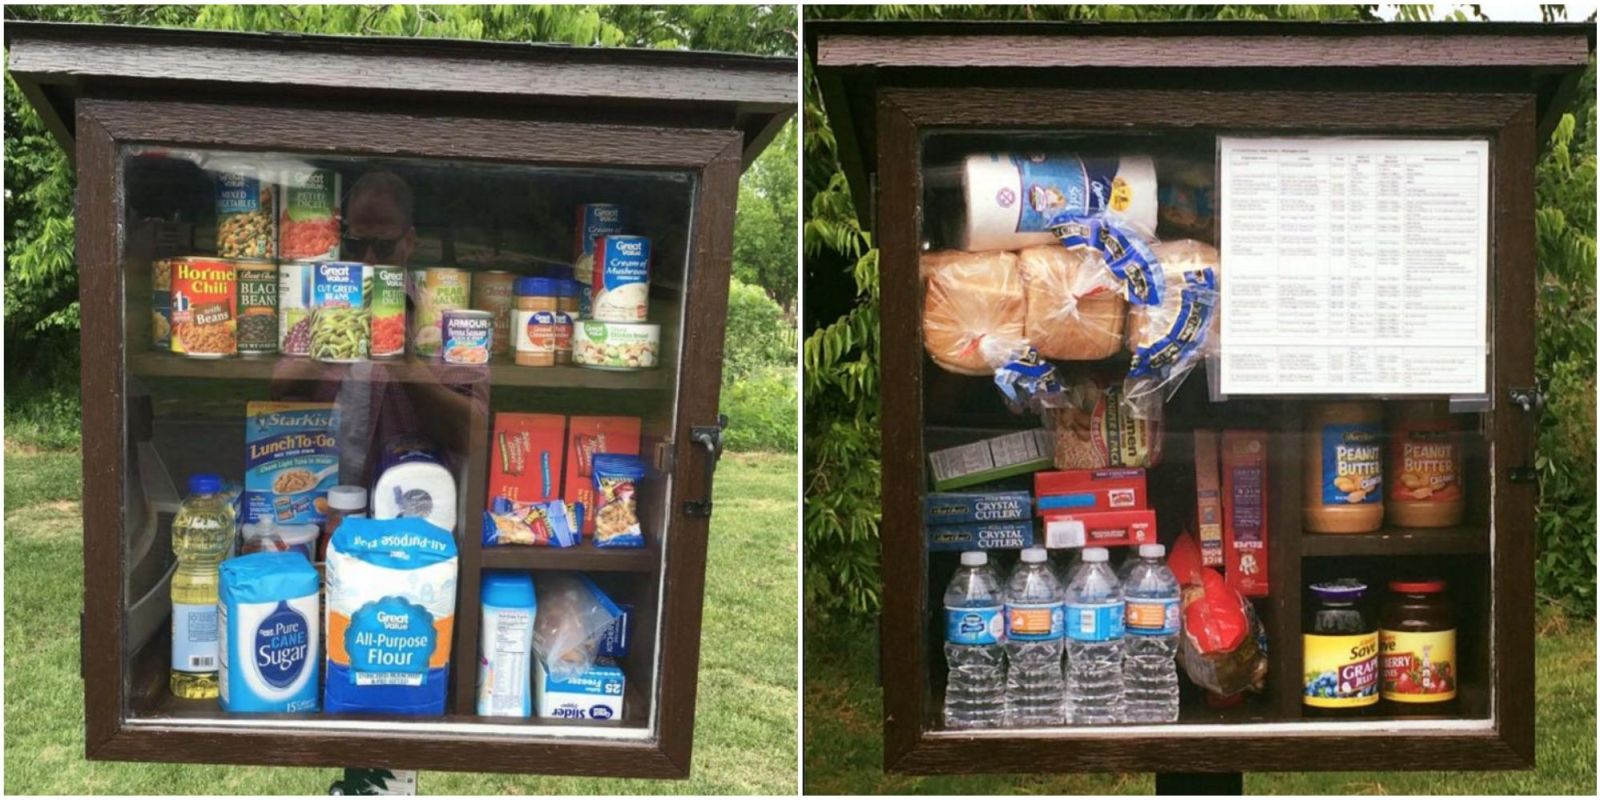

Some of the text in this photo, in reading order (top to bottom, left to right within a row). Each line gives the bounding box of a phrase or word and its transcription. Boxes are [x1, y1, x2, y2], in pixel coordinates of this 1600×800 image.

[222, 190, 247, 199] MIXED
[616, 241, 642, 250] Great
[610, 258, 648, 269] Cream of
[320, 264, 350, 276] Great
[607, 267, 648, 275] Mushroom
[326, 275, 350, 283] Value
[191, 280, 228, 294] Chili
[317, 284, 358, 293] CUT GREEN
[196, 312, 229, 325] Beans
[448, 319, 488, 328] ARMOUR
[269, 413, 334, 427] StarKist
[1126, 415, 1137, 457] men
[250, 435, 295, 460] Lunch
[1336, 445, 1379, 461] PEANUT
[1404, 444, 1452, 459] PEANUT
[1404, 458, 1453, 472] BUTTER
[975, 500, 1019, 511] CRYSTAL
[975, 509, 1022, 520] CUTLERY
[978, 530, 1022, 538] CRYSTAL
[381, 534, 447, 551] All-Purpose
[978, 539, 1025, 548] CUTLERY
[1233, 541, 1263, 549] HELPER
[1202, 556, 1222, 566] RICE
[377, 611, 409, 624] Great
[276, 622, 299, 635] Pure
[384, 622, 409, 631] Value
[271, 631, 305, 649] CANE
[355, 631, 428, 652] All-Purpose
[1382, 640, 1396, 651] ve
[258, 644, 307, 671] Sugar
[368, 648, 414, 666] Flour
[1342, 658, 1378, 680] GRAP
[568, 678, 602, 688] Freezer
[605, 683, 621, 694] 25
[287, 702, 297, 713] 15
[552, 707, 586, 720] Slider
